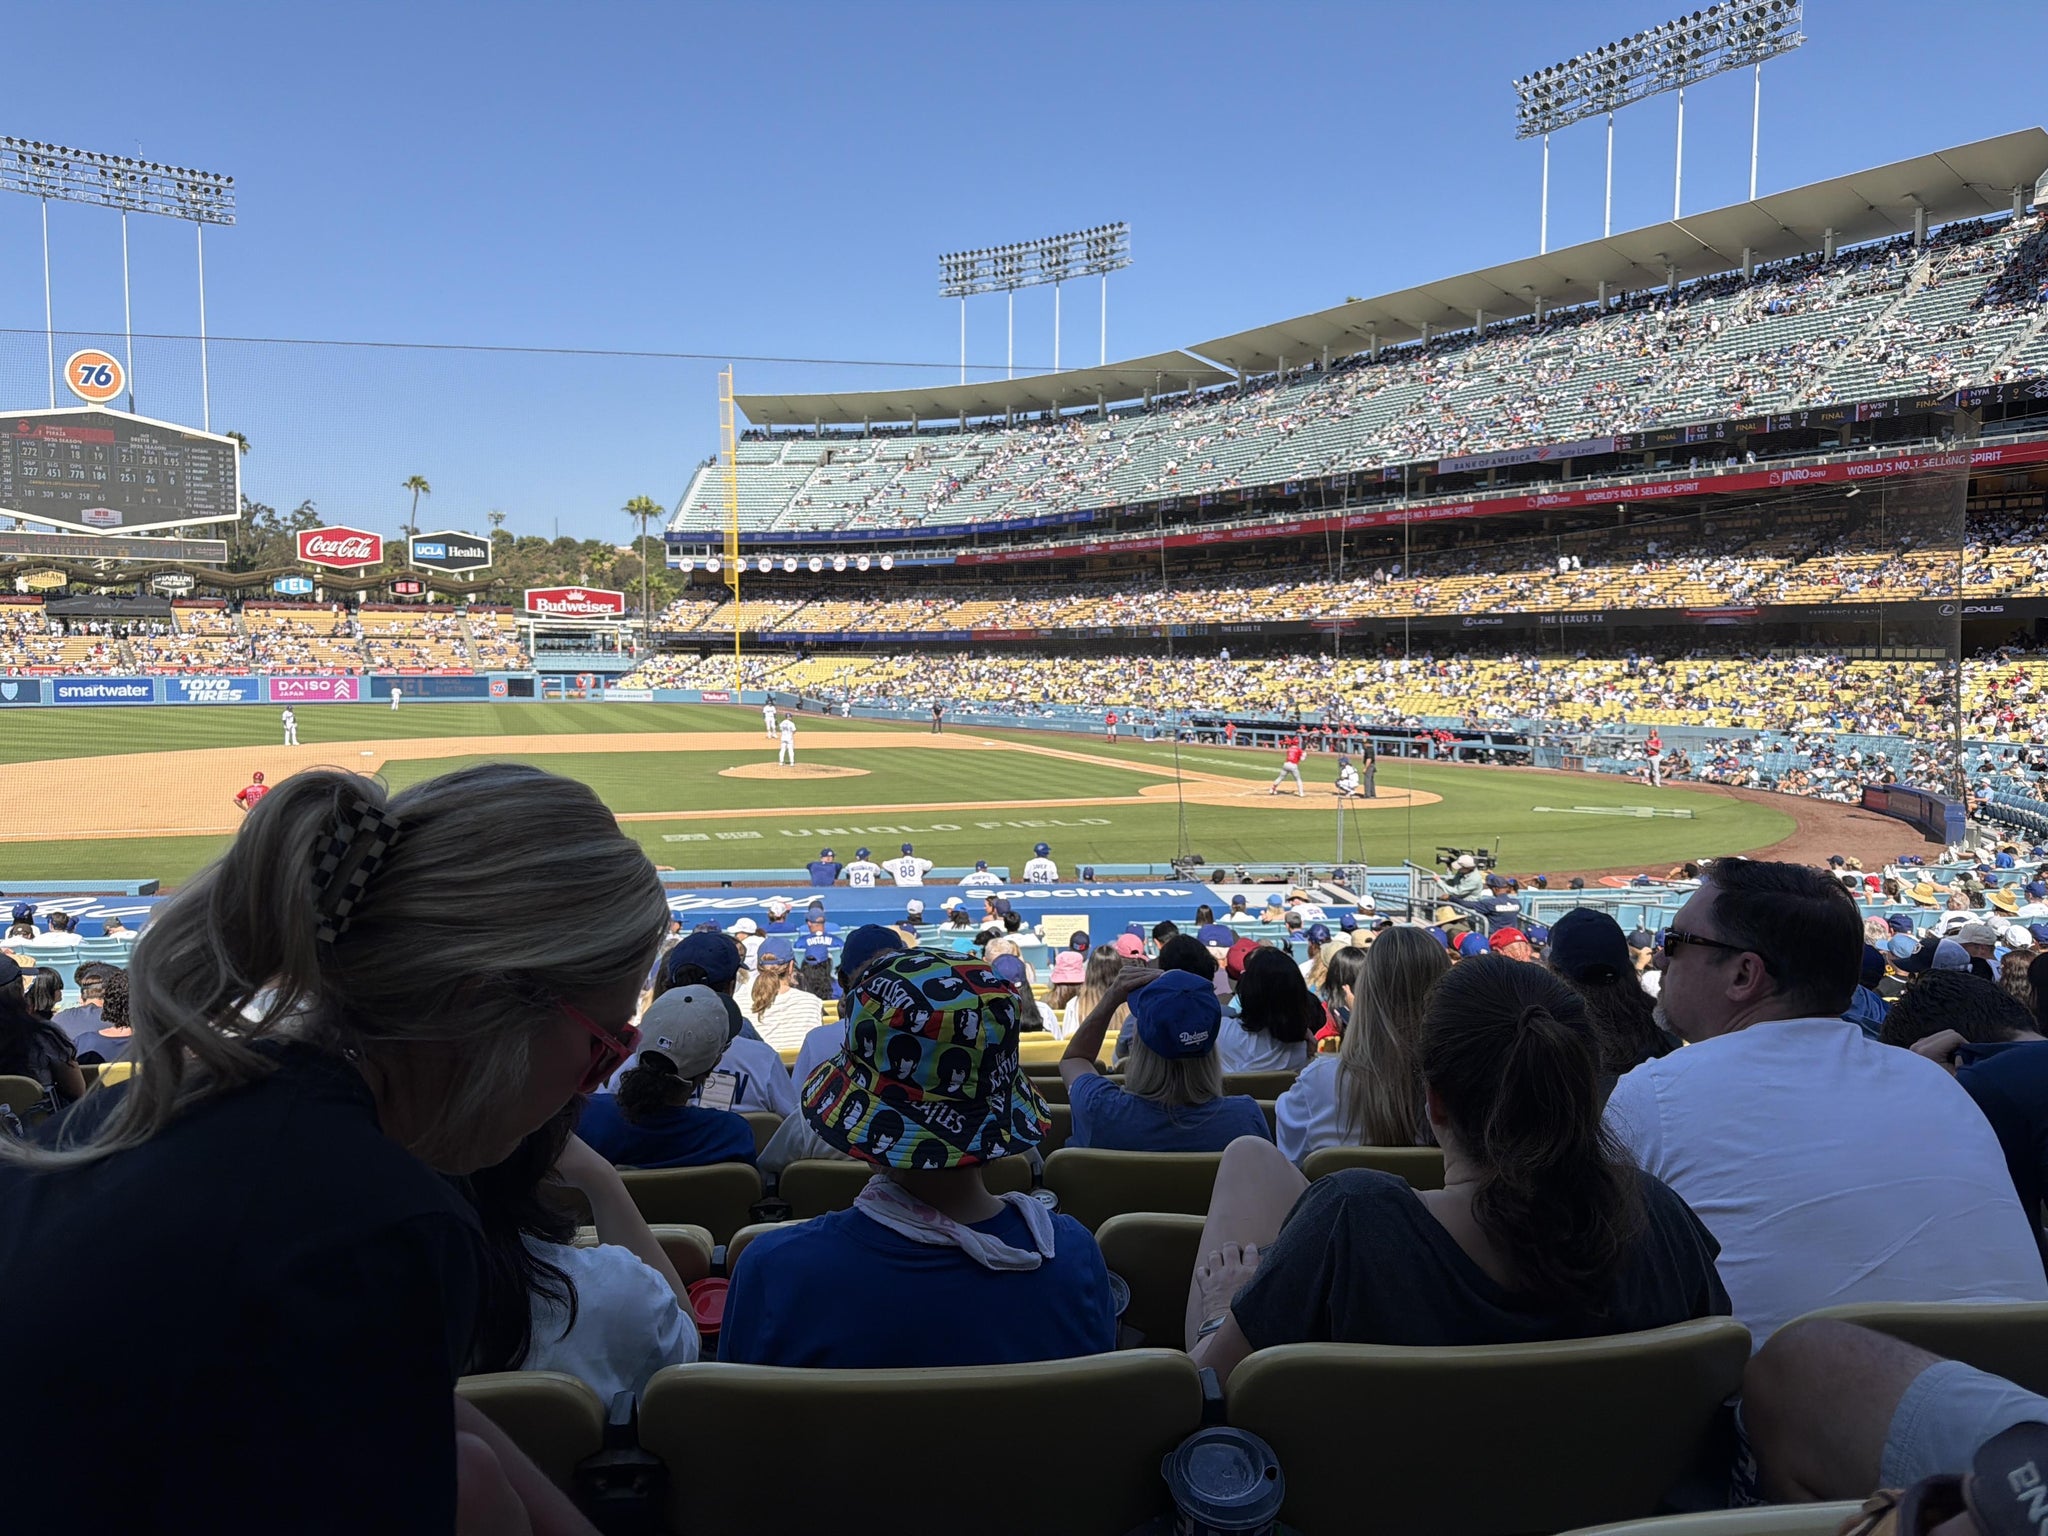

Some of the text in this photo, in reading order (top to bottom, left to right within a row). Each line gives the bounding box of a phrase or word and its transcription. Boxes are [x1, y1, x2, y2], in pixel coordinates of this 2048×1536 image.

[79, 364, 113, 387] 76
[1970, 388, 1989, 397] NYM
[1996, 386, 2003, 394] 7
[1869, 401, 1888, 410] WSH
[1821, 411, 1844, 420] FINAL
[1735, 423, 1756, 431] FINAL
[1657, 433, 1676, 442] FINAL
[21, 448, 37, 456] .272
[164, 458, 179, 466] 0.95
[1454, 461, 1477, 470] BANK
[1478, 460, 1489, 468] OF
[1491, 454, 1530, 466] AMERICA
[1847, 462, 1892, 476] WORLD'S
[1922, 454, 1966, 468] SELLING
[1970, 451, 2002, 464] SPIRIT
[22, 468, 38, 476] .327
[45, 469, 61, 477] .451
[68, 470, 85, 479] .778
[1782, 468, 1809, 483] JINRO
[120, 474, 135, 482] 25.1
[146, 475, 155, 484] 26
[1585, 490, 1619, 502] WORLD'S
[1641, 485, 1672, 496] SELLING
[1674, 482, 1699, 493] SPIRIT
[1429, 507, 1454, 516] SELLING
[1455, 505, 1474, 515] SPIRIT
[306, 536, 374, 559] Coca-Cola
[416, 546, 485, 558] UCLA Health
[279, 578, 310, 591] TEL
[536, 598, 616, 613] Budweiser
[1960, 604, 2004, 614] LEXUS
[1540, 614, 1604, 624] THE LEXUS TX
[180, 679, 231, 690] TOYO
[278, 680, 330, 691] DAISO
[493, 684, 505, 693] 76
[58, 684, 148, 698] smartwater
[188, 690, 244, 701] TIRES
[778, 824, 962, 837] UNIQLO
[974, 818, 1112, 829] FIELD
[900, 866, 915, 878] 88
[1032, 871, 1048, 883] 94
[854, 872, 869, 884] 84
[966, 887, 1172, 899] Spectrum
[806, 936, 833, 948] OHTANI
